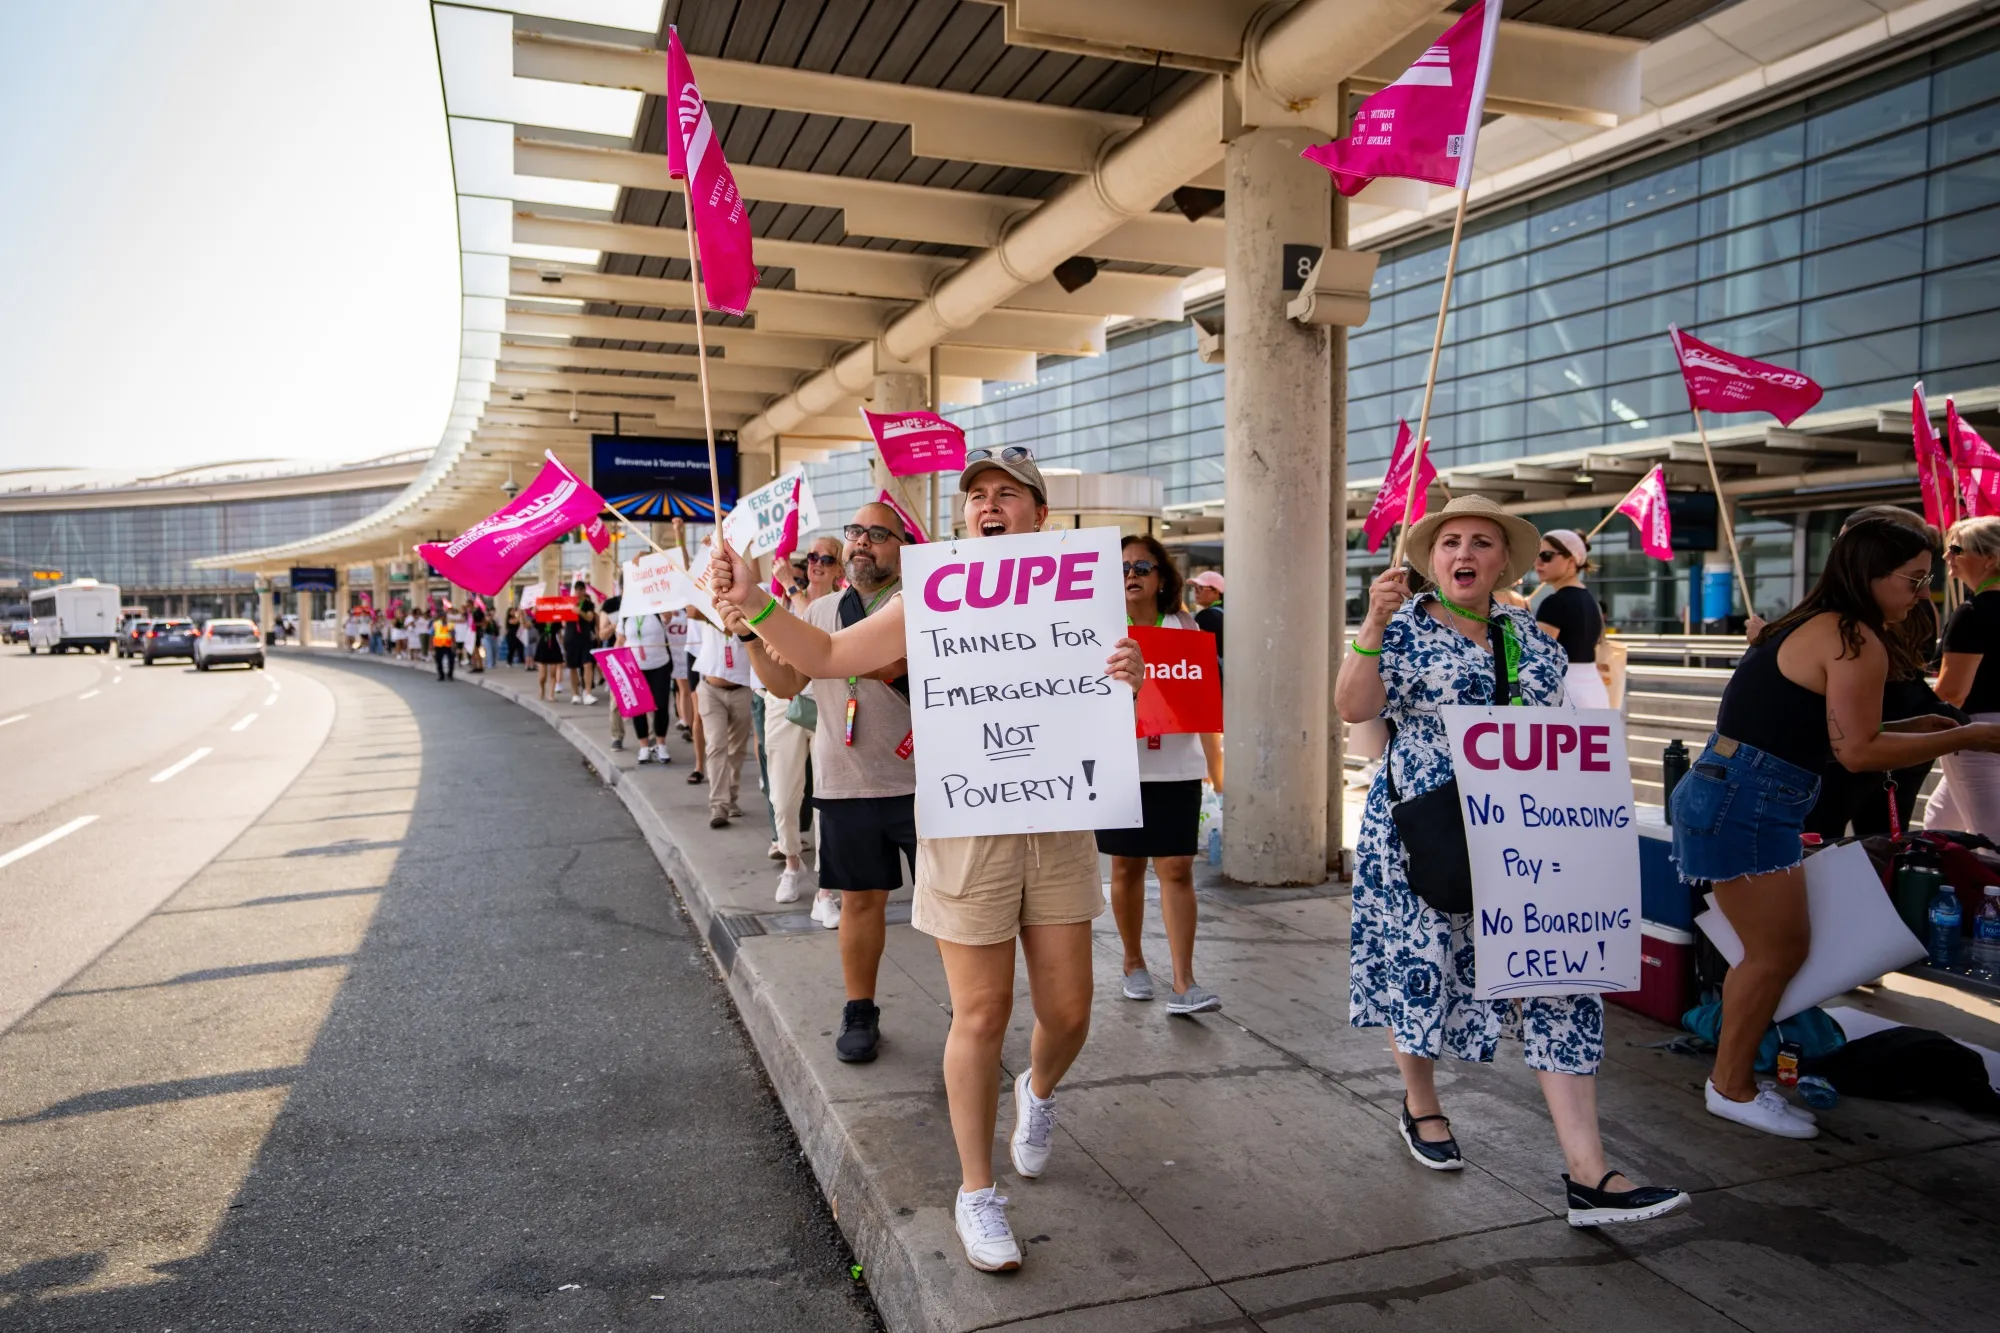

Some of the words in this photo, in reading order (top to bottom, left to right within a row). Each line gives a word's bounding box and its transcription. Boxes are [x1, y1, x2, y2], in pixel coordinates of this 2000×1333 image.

[1297, 256, 1312, 279] 8
[614, 457, 652, 467] Bienvenue
[653, 459, 658, 467] à
[659, 459, 686, 468] Toronto
[687, 460, 711, 470] Pearso
[757, 497, 792, 530] NO
[758, 513, 809, 548] CHAY
[923, 551, 1100, 613] CUPE
[668, 624, 688, 635] CU
[920, 627, 1037, 658] TRAINED
[1050, 621, 1102, 649] FOR
[1142, 659, 1203, 680] nada
[923, 675, 1112, 710] EMERGENCIES
[983, 722, 1040, 750] NOT
[1463, 722, 1611, 772] CUPE
